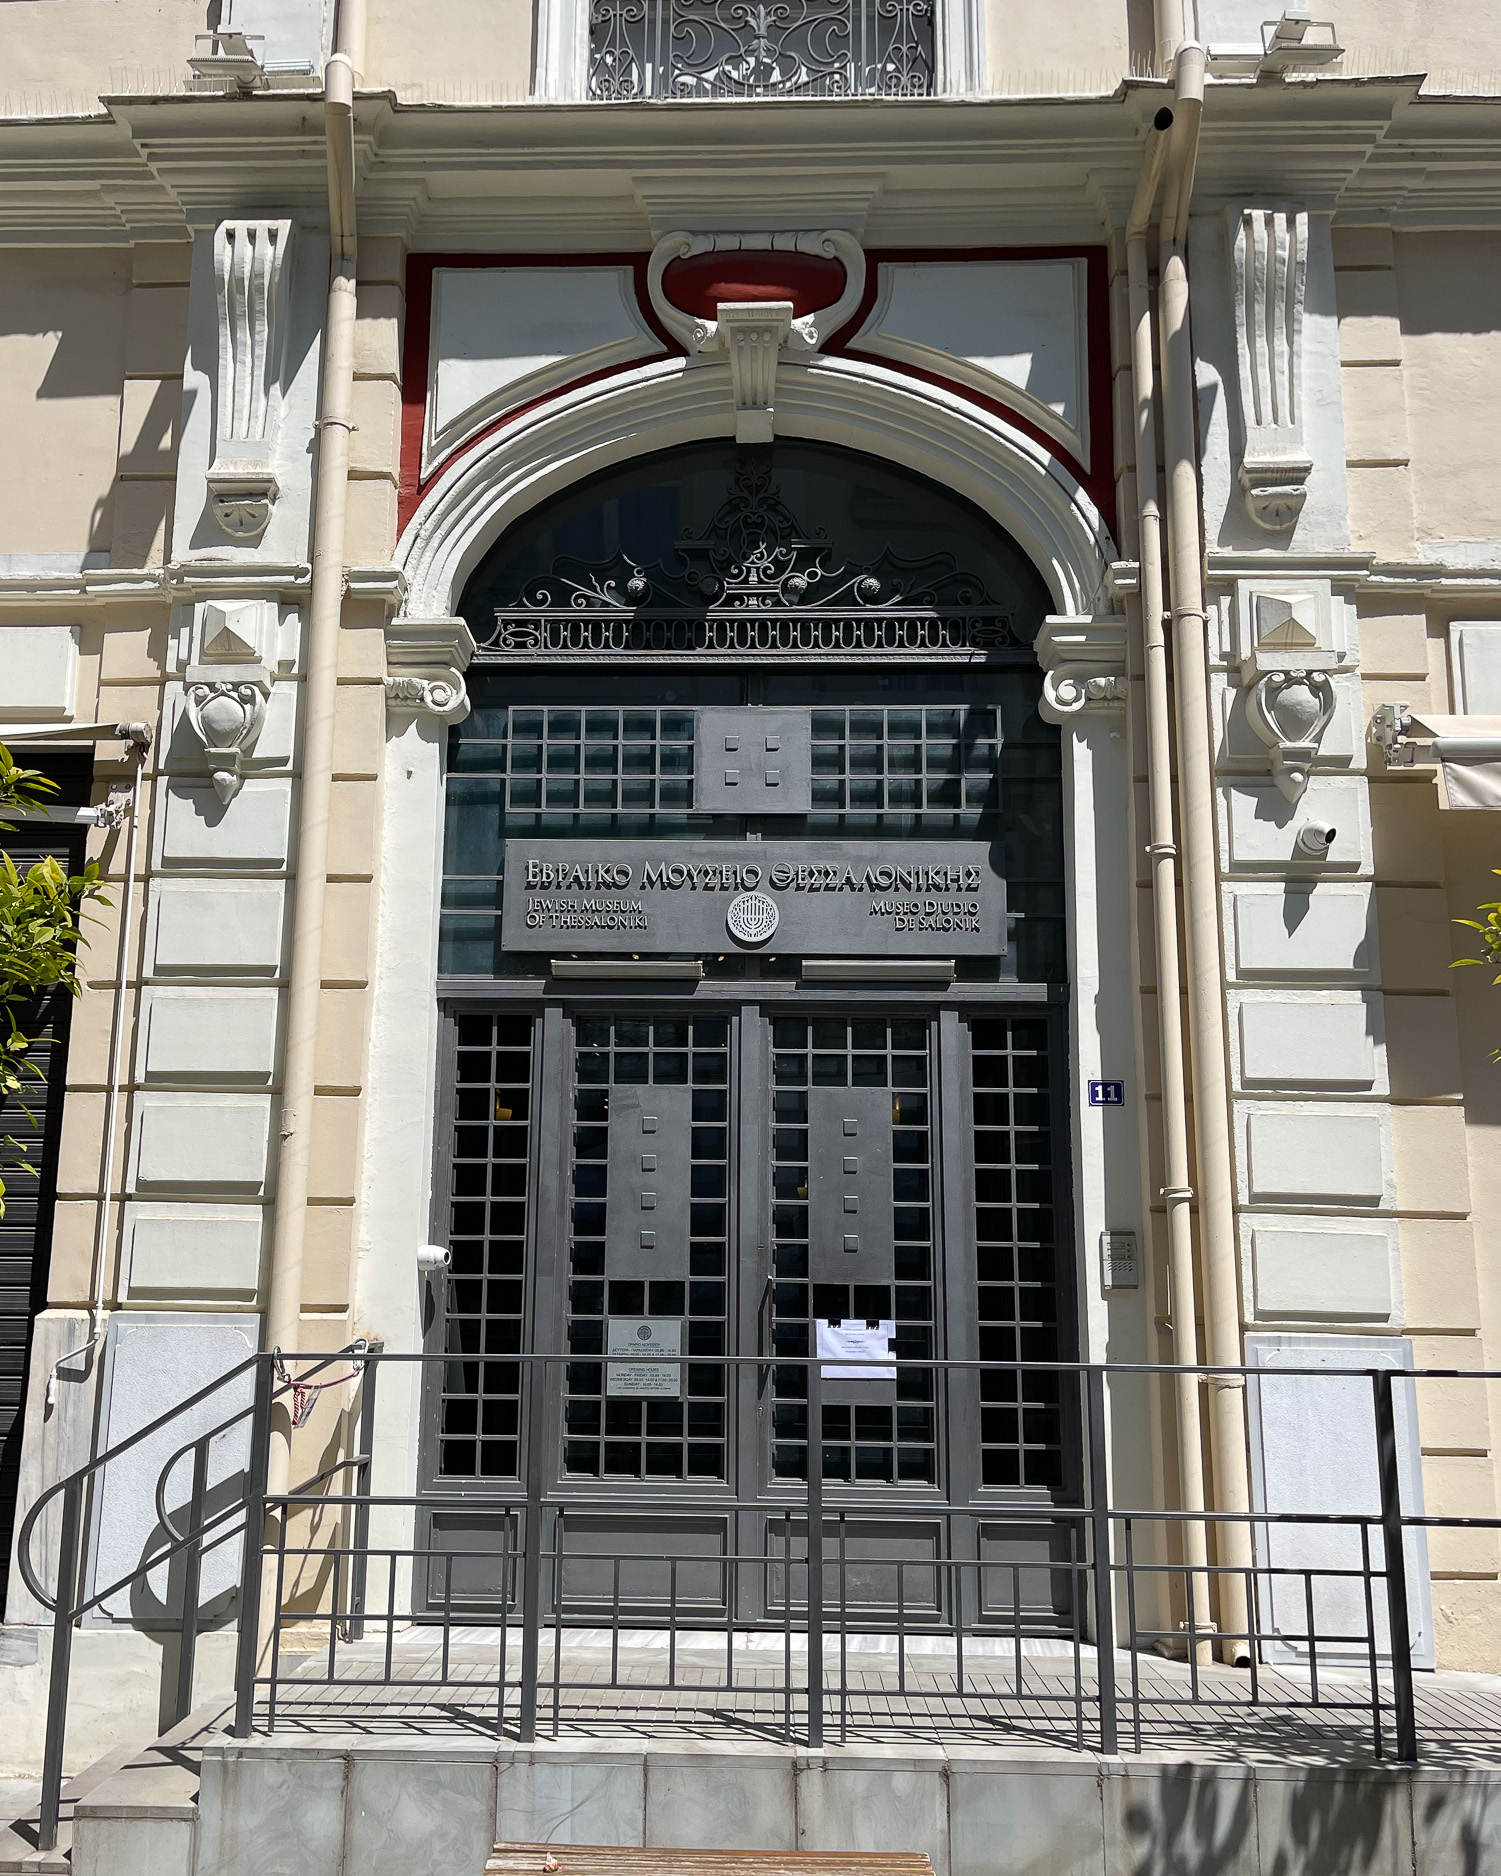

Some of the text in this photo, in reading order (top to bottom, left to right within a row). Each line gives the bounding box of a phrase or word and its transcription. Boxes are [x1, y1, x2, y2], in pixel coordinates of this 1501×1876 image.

[526, 859, 982, 884] ΕΒΡΑΙΚΟ ΜΟΥΣΕΙΟ ΘΕΣΣΑΛΟΝΙΚΗΣ
[527, 897, 643, 912] JEWISH MUSEUM
[870, 900, 980, 914] MUSEO DJUDIO
[526, 913, 648, 926] OF THESSALONIKI
[895, 916, 915, 928] DE
[1095, 1085, 1118, 1101] 11
